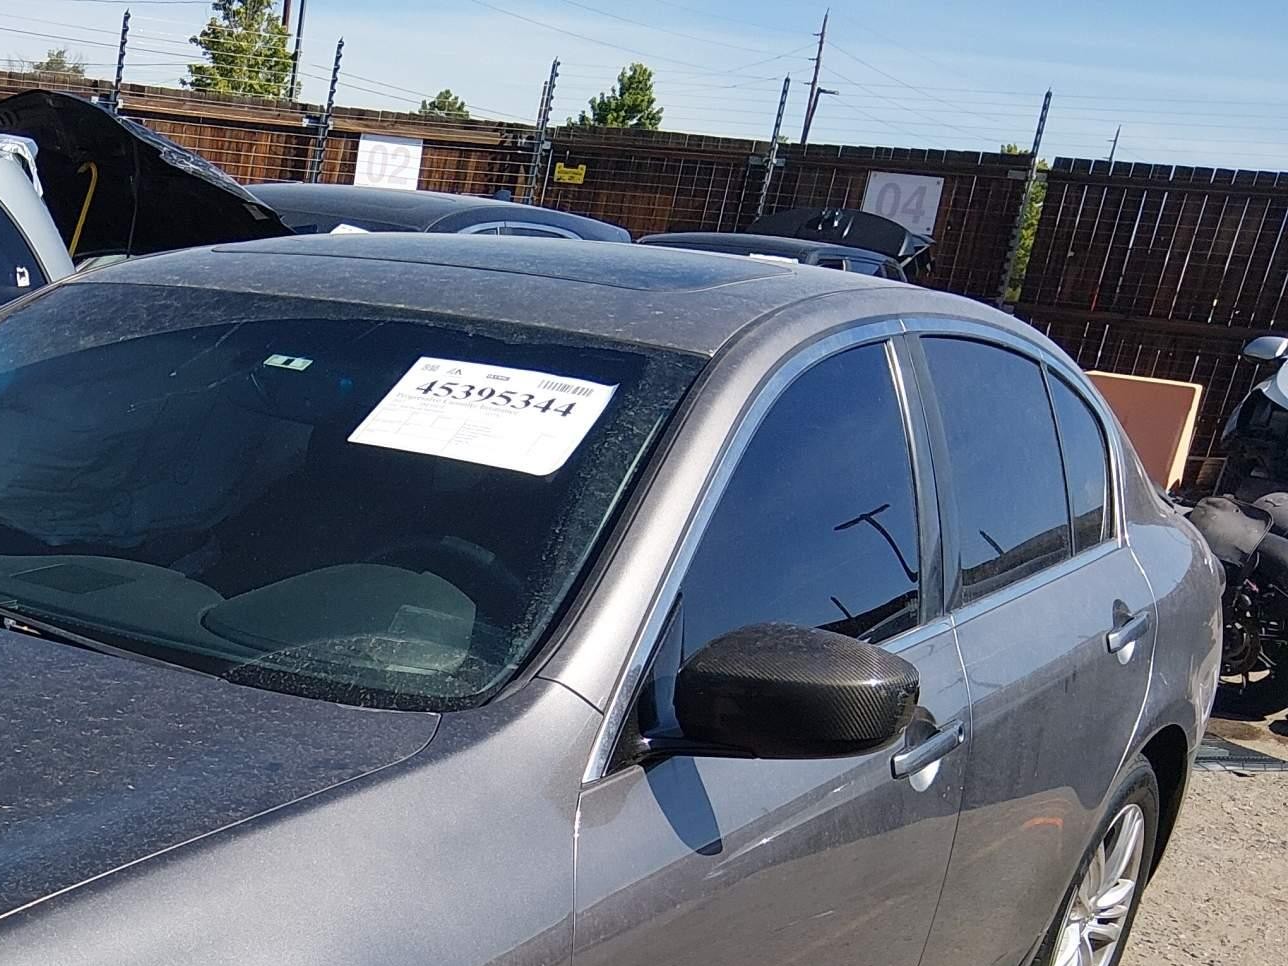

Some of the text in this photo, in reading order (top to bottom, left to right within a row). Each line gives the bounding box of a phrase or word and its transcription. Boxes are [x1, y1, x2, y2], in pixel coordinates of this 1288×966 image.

[366, 144, 411, 184] 02
[875, 182, 928, 224] 04
[414, 380, 579, 418] 45395344
